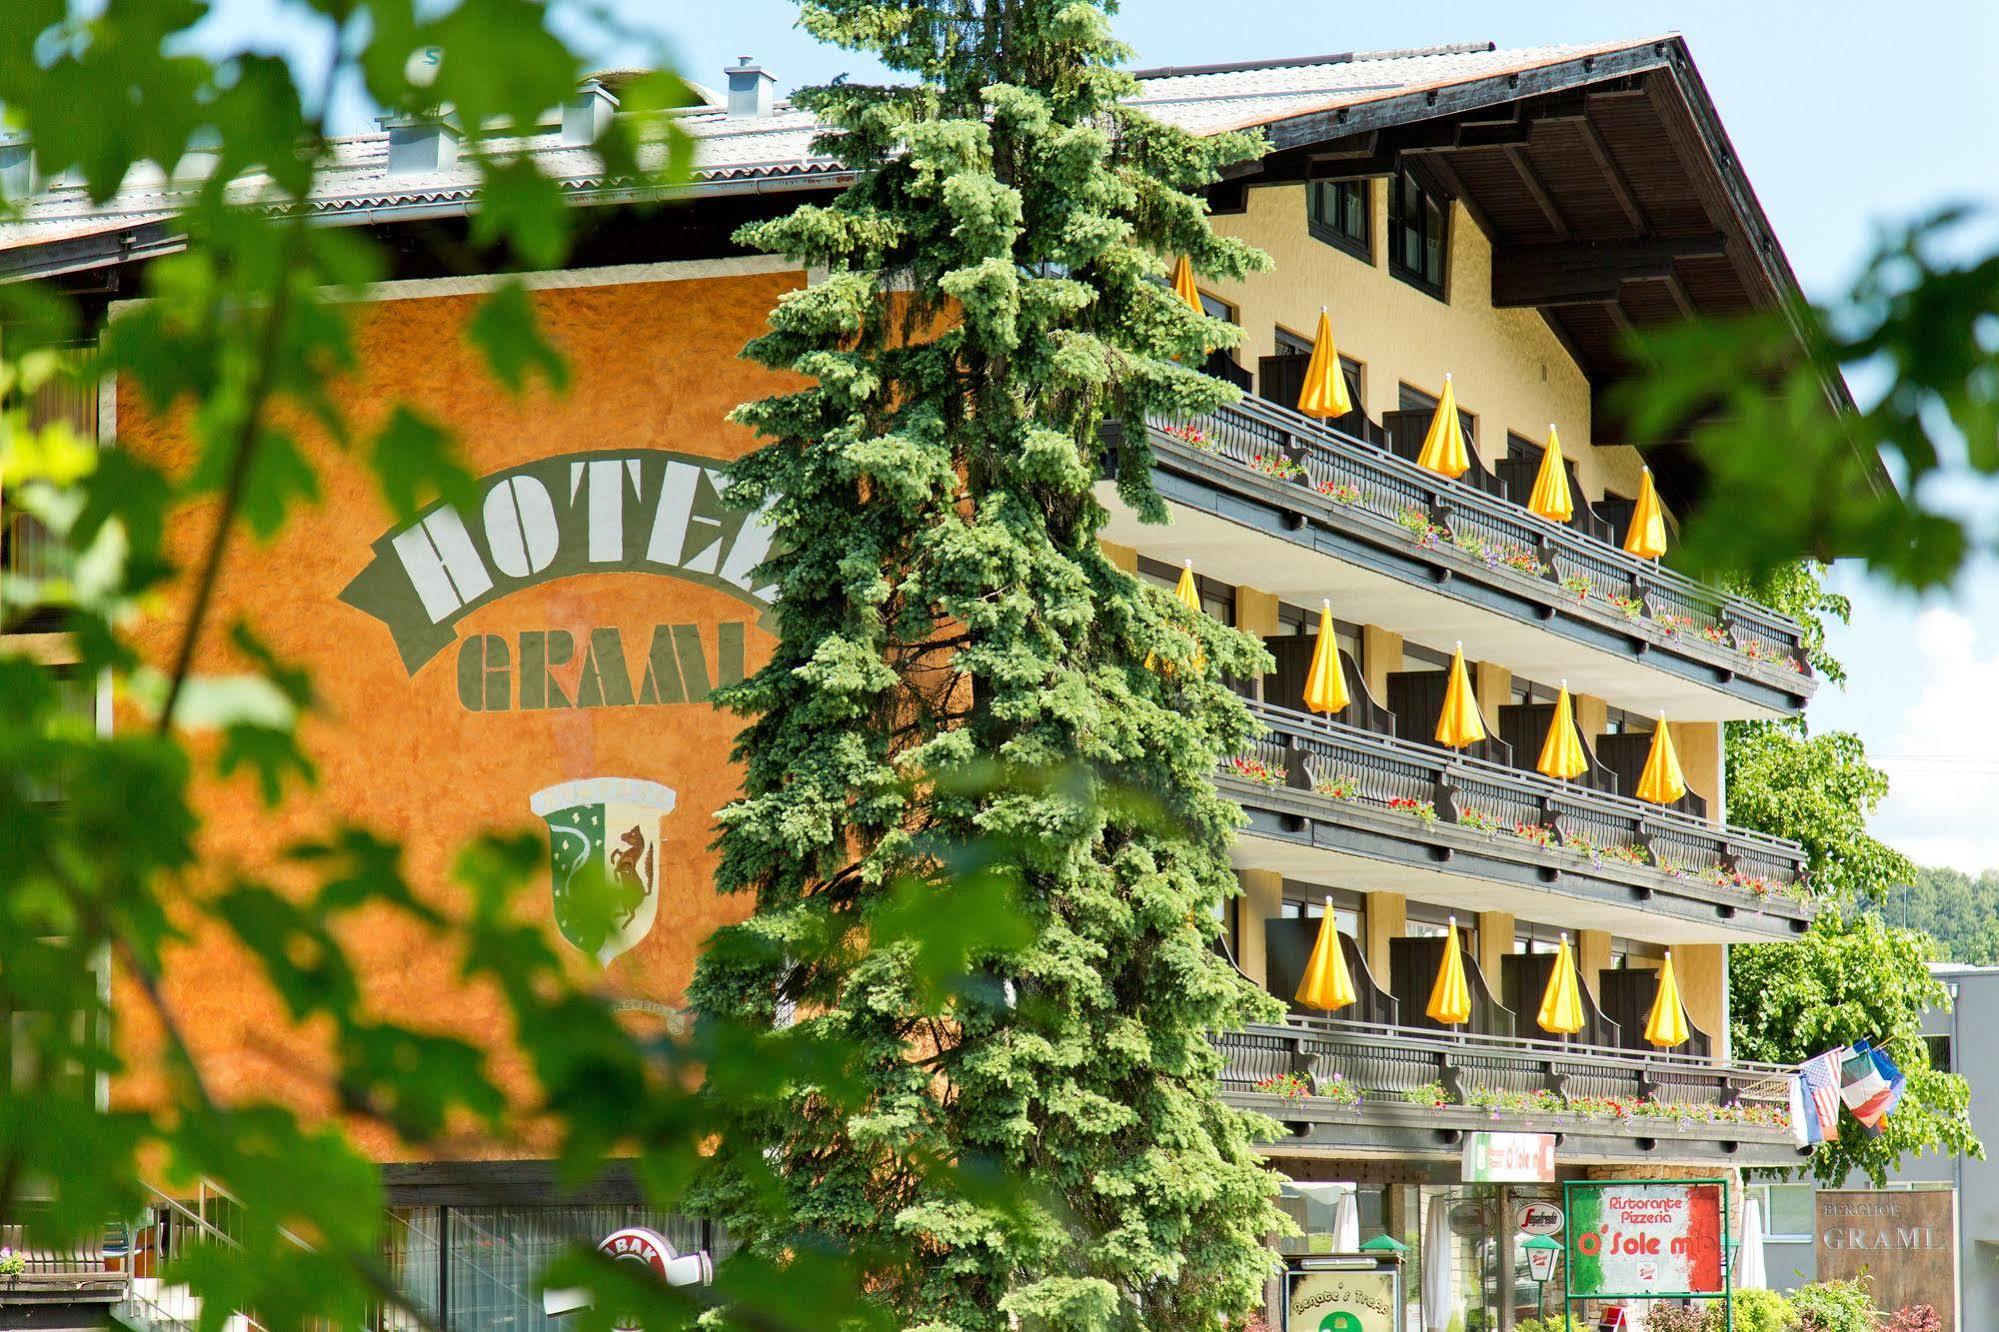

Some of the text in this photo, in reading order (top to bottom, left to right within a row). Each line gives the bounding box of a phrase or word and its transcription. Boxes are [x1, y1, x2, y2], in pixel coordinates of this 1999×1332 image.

[392, 459, 784, 625] HOTEL
[1609, 1196, 1682, 1212] Ristorante
[1621, 1211, 1672, 1224] Pizzeria
[1823, 1226, 1946, 1249] GRAML
